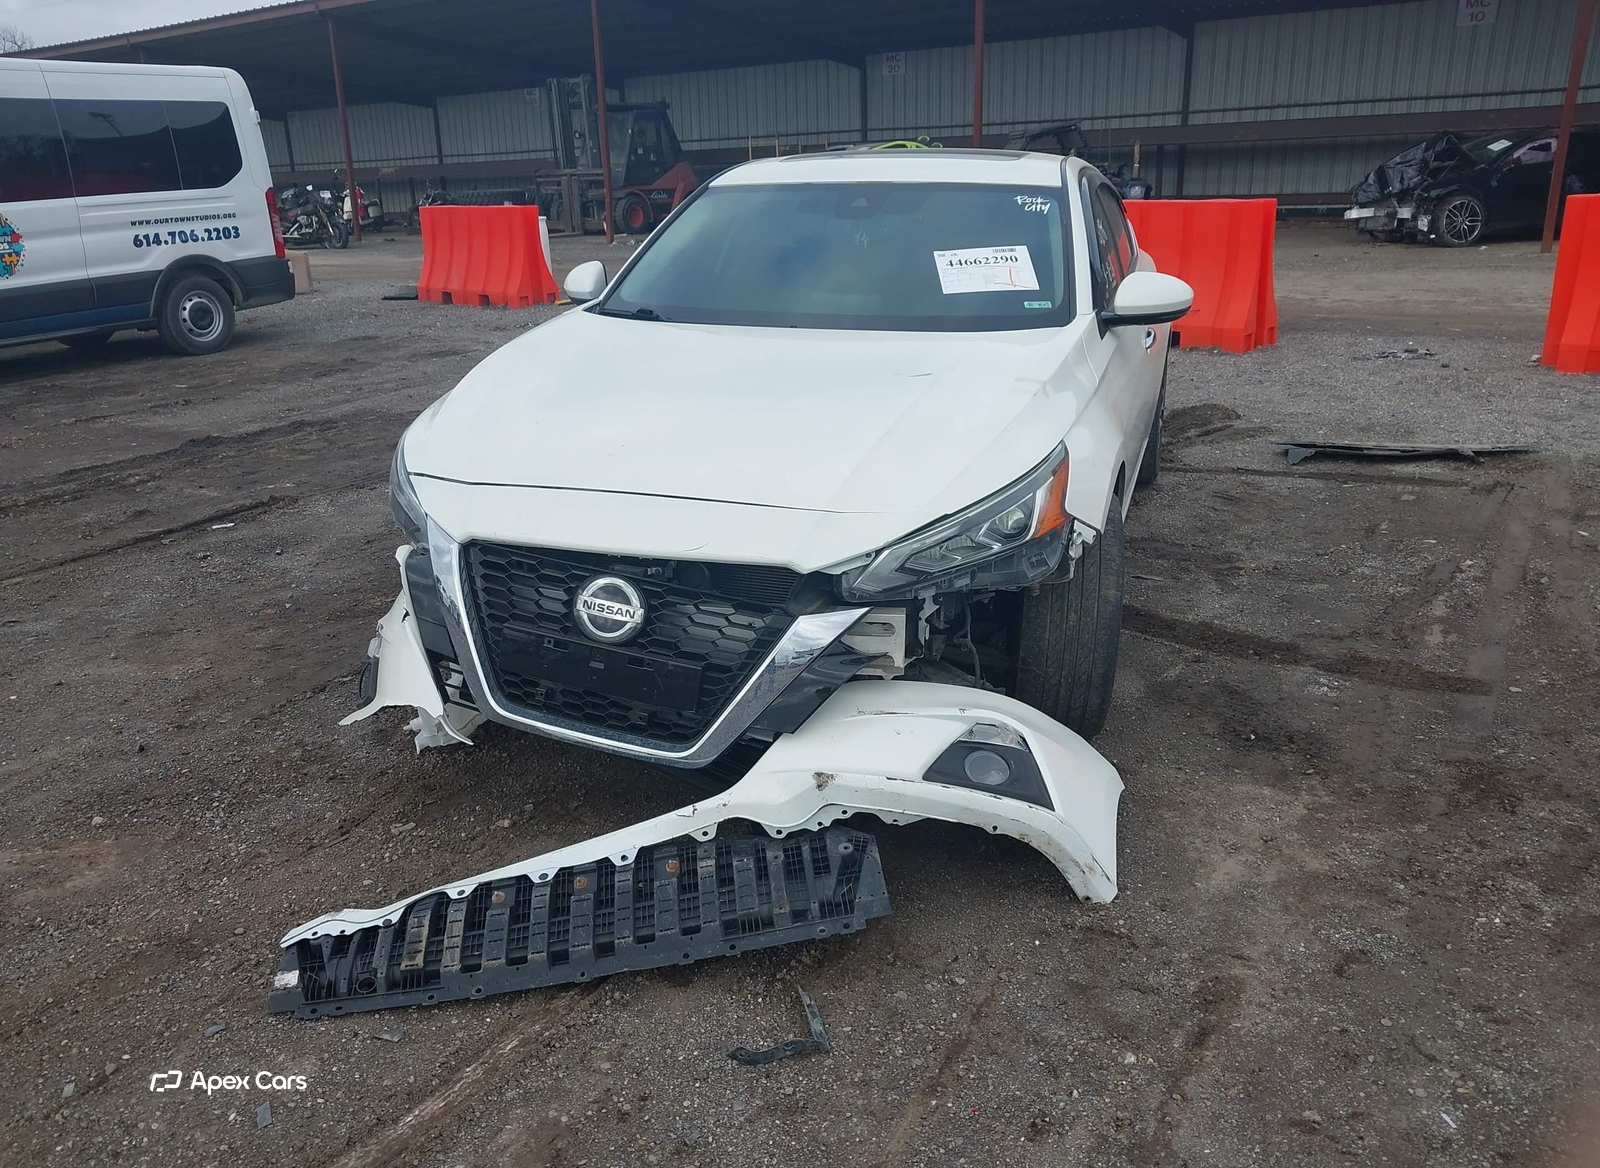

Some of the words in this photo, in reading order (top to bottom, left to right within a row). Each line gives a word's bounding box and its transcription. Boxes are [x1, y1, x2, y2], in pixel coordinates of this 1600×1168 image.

[1468, 11, 1486, 22] 10
[885, 54, 902, 63] MC
[887, 64, 900, 74] 20
[130, 212, 237, 226] WWW.OURTOWNSTUDIOS.ORG
[132, 225, 241, 248] 614.706.2203
[945, 254, 1018, 268] 44662290
[582, 599, 636, 619] NISSAN
